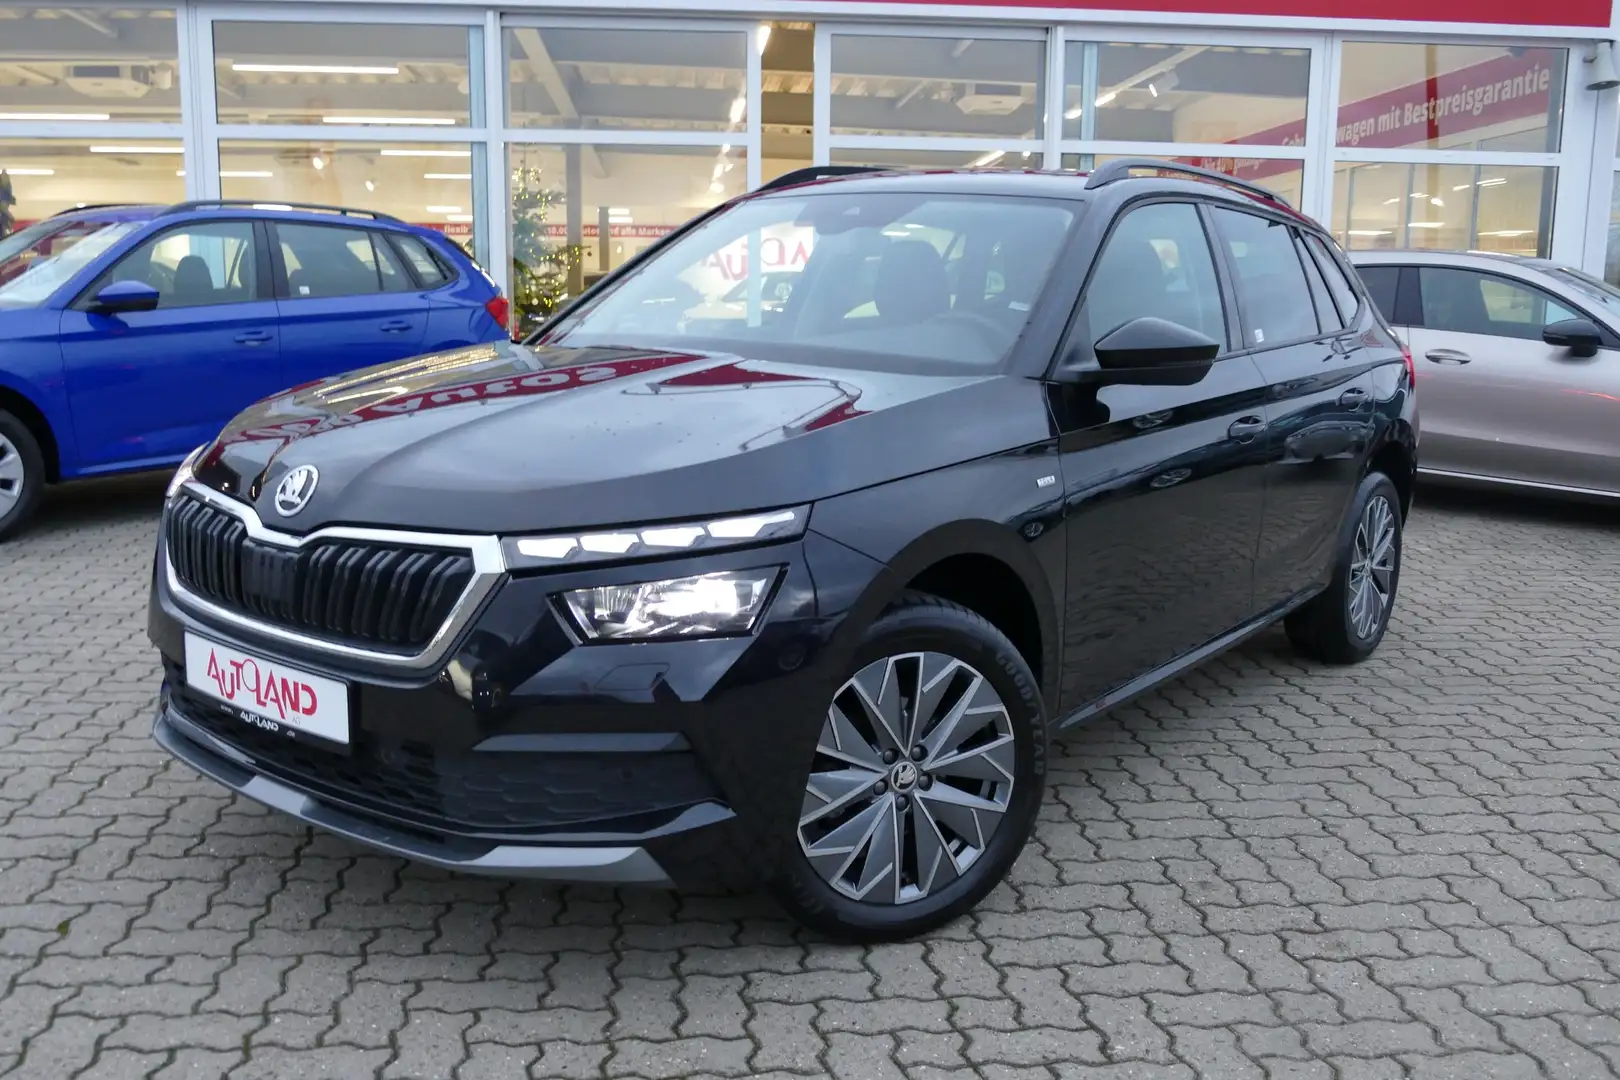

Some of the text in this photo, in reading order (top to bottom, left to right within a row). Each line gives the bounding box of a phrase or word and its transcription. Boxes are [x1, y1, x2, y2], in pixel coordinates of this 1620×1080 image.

[1378, 106, 1401, 133] mit
[1404, 62, 1550, 126] Bestpreisgarantie
[207, 647, 318, 719] AUTOLAND
